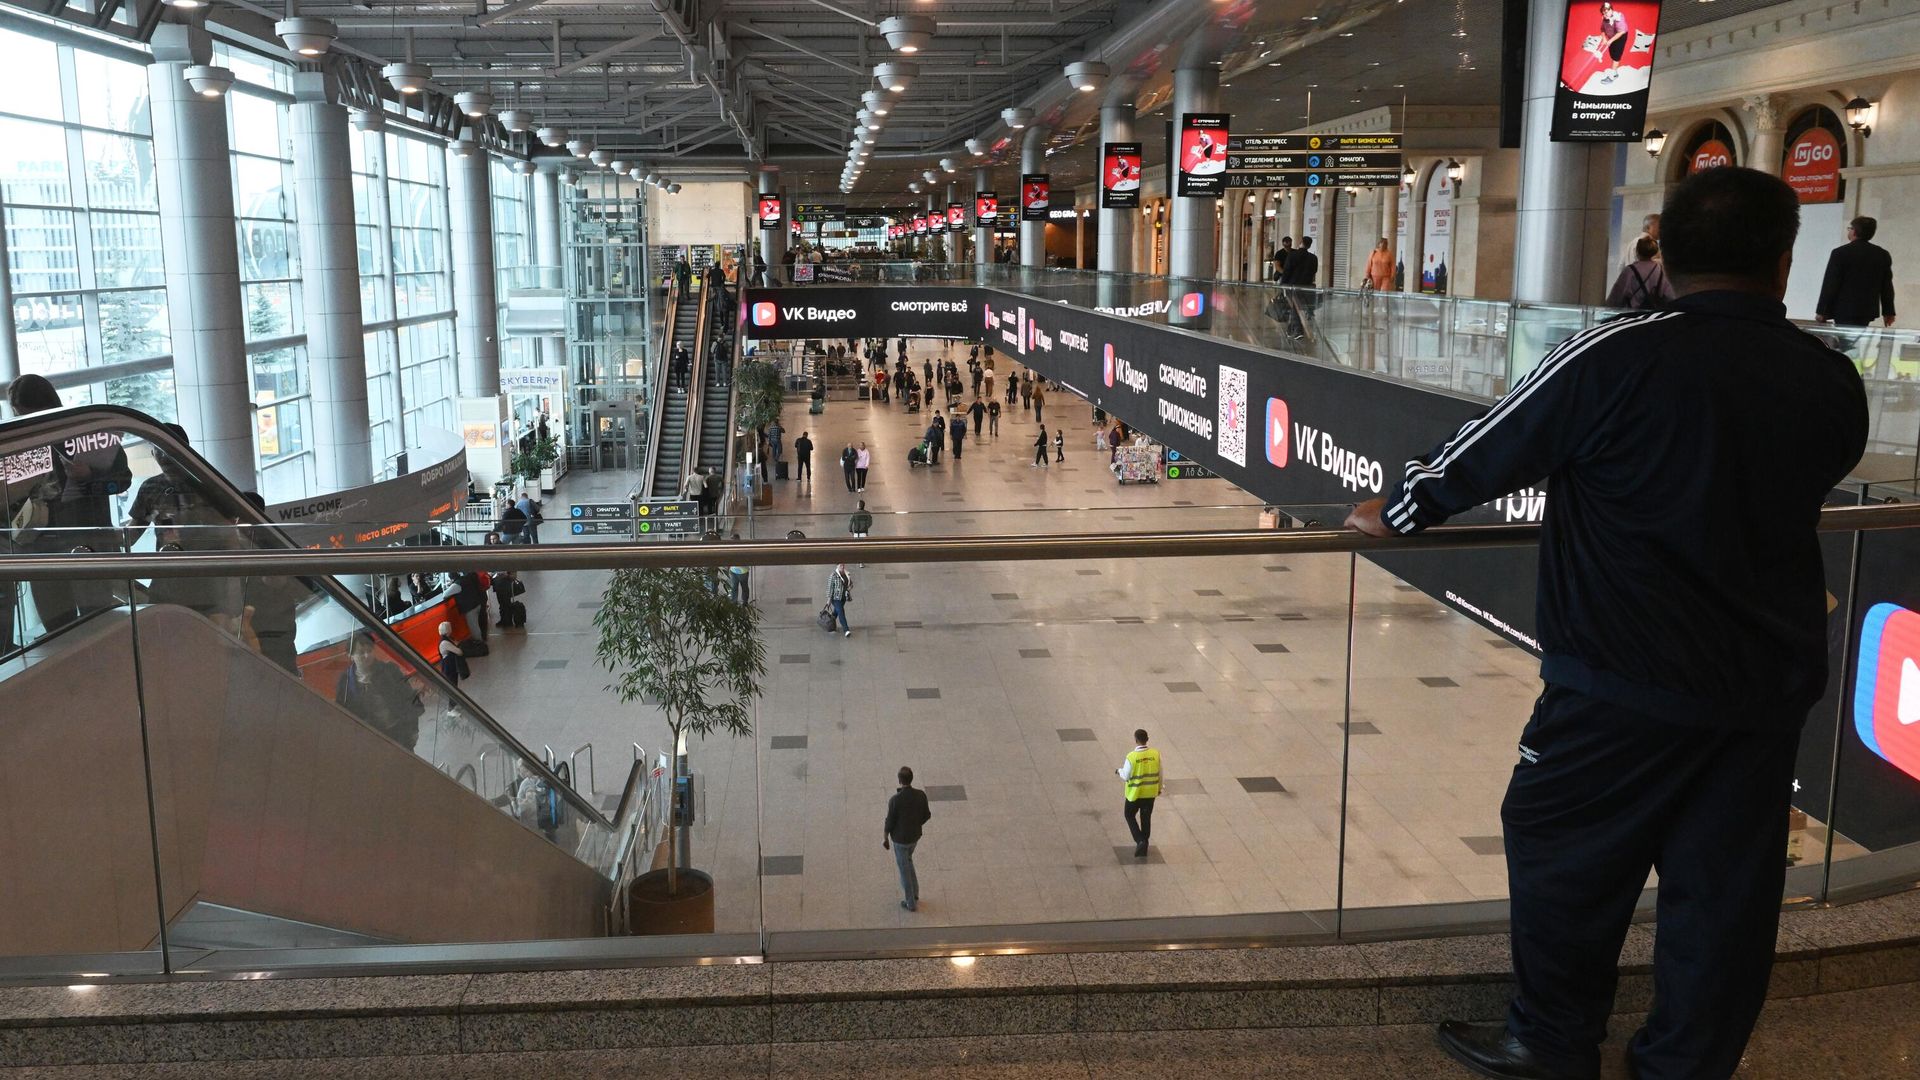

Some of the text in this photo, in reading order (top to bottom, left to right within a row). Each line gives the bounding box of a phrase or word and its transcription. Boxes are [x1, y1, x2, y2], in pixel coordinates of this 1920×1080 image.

[1574, 100, 1632, 110] Намылились
[1580, 111, 1616, 120] отпуск?
[782, 307, 856, 322] VK Видео
[891, 300, 968, 314] смотрите всё
[501, 376, 558, 385] SKYBERRY
[1115, 357, 1124, 382] VK
[1126, 360, 1148, 394] Видео
[1159, 363, 1206, 398] скачивайте
[1159, 398, 1212, 440] приложение
[1294, 422, 1383, 494] VK Видео
[421, 466, 444, 487] ДОБРО
[279, 498, 342, 520] WELCOME
[355, 522, 409, 543] Место встречи
[1446, 590, 1456, 601] ООО
